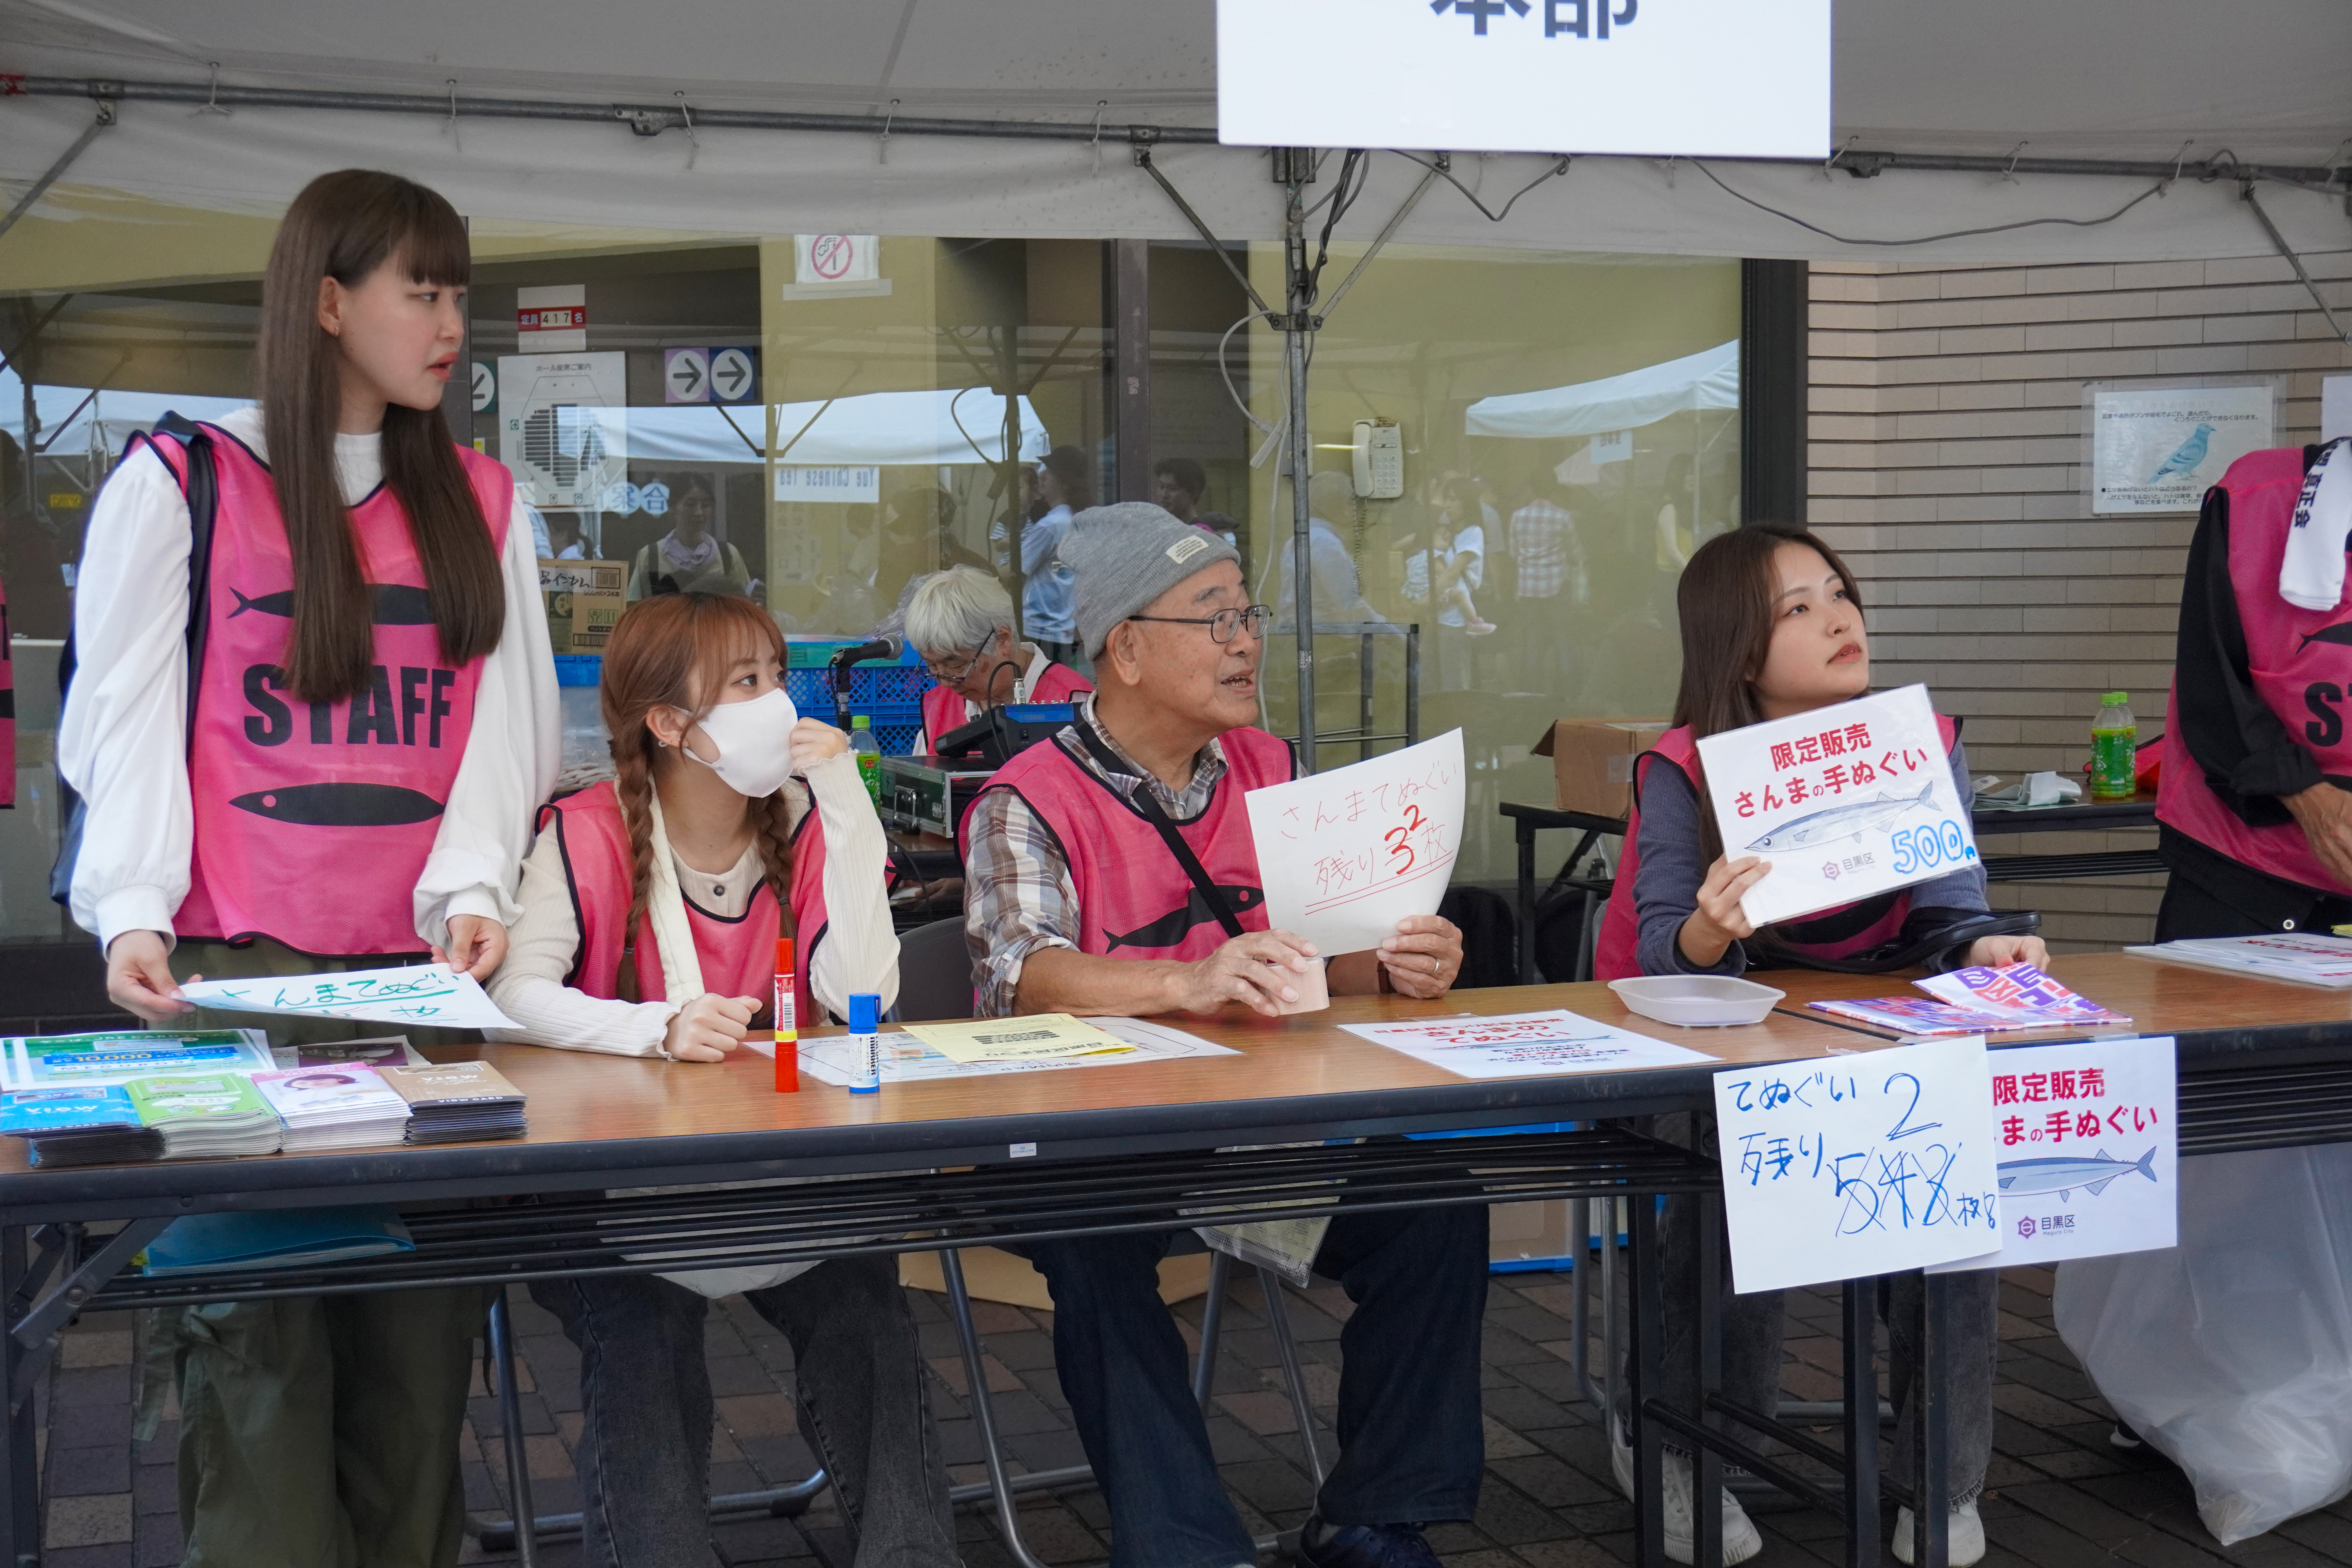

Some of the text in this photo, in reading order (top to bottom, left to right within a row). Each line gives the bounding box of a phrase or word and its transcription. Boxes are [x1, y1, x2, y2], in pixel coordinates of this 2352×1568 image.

[521, 312, 583, 325] 定員 417 名
[2304, 682, 2352, 747] S
[1770, 722, 1872, 771] 限定販売
[1280, 760, 1457, 839] さんまてぬぐい
[1735, 748, 1927, 818] さんまの手ぬぐい
[1842, 852, 1876, 871] 目黒区
[1421, 1025, 1550, 1037] さんまの
[1435, 1031, 1571, 1043] てぬぐい
[1728, 1072, 1942, 1141] てぬぐい 2
[1993, 1068, 2105, 1106] 限定販売
[1994, 1105, 2158, 1145] まの手ぬぐい
[2041, 1215, 2075, 1230] 目黒区
